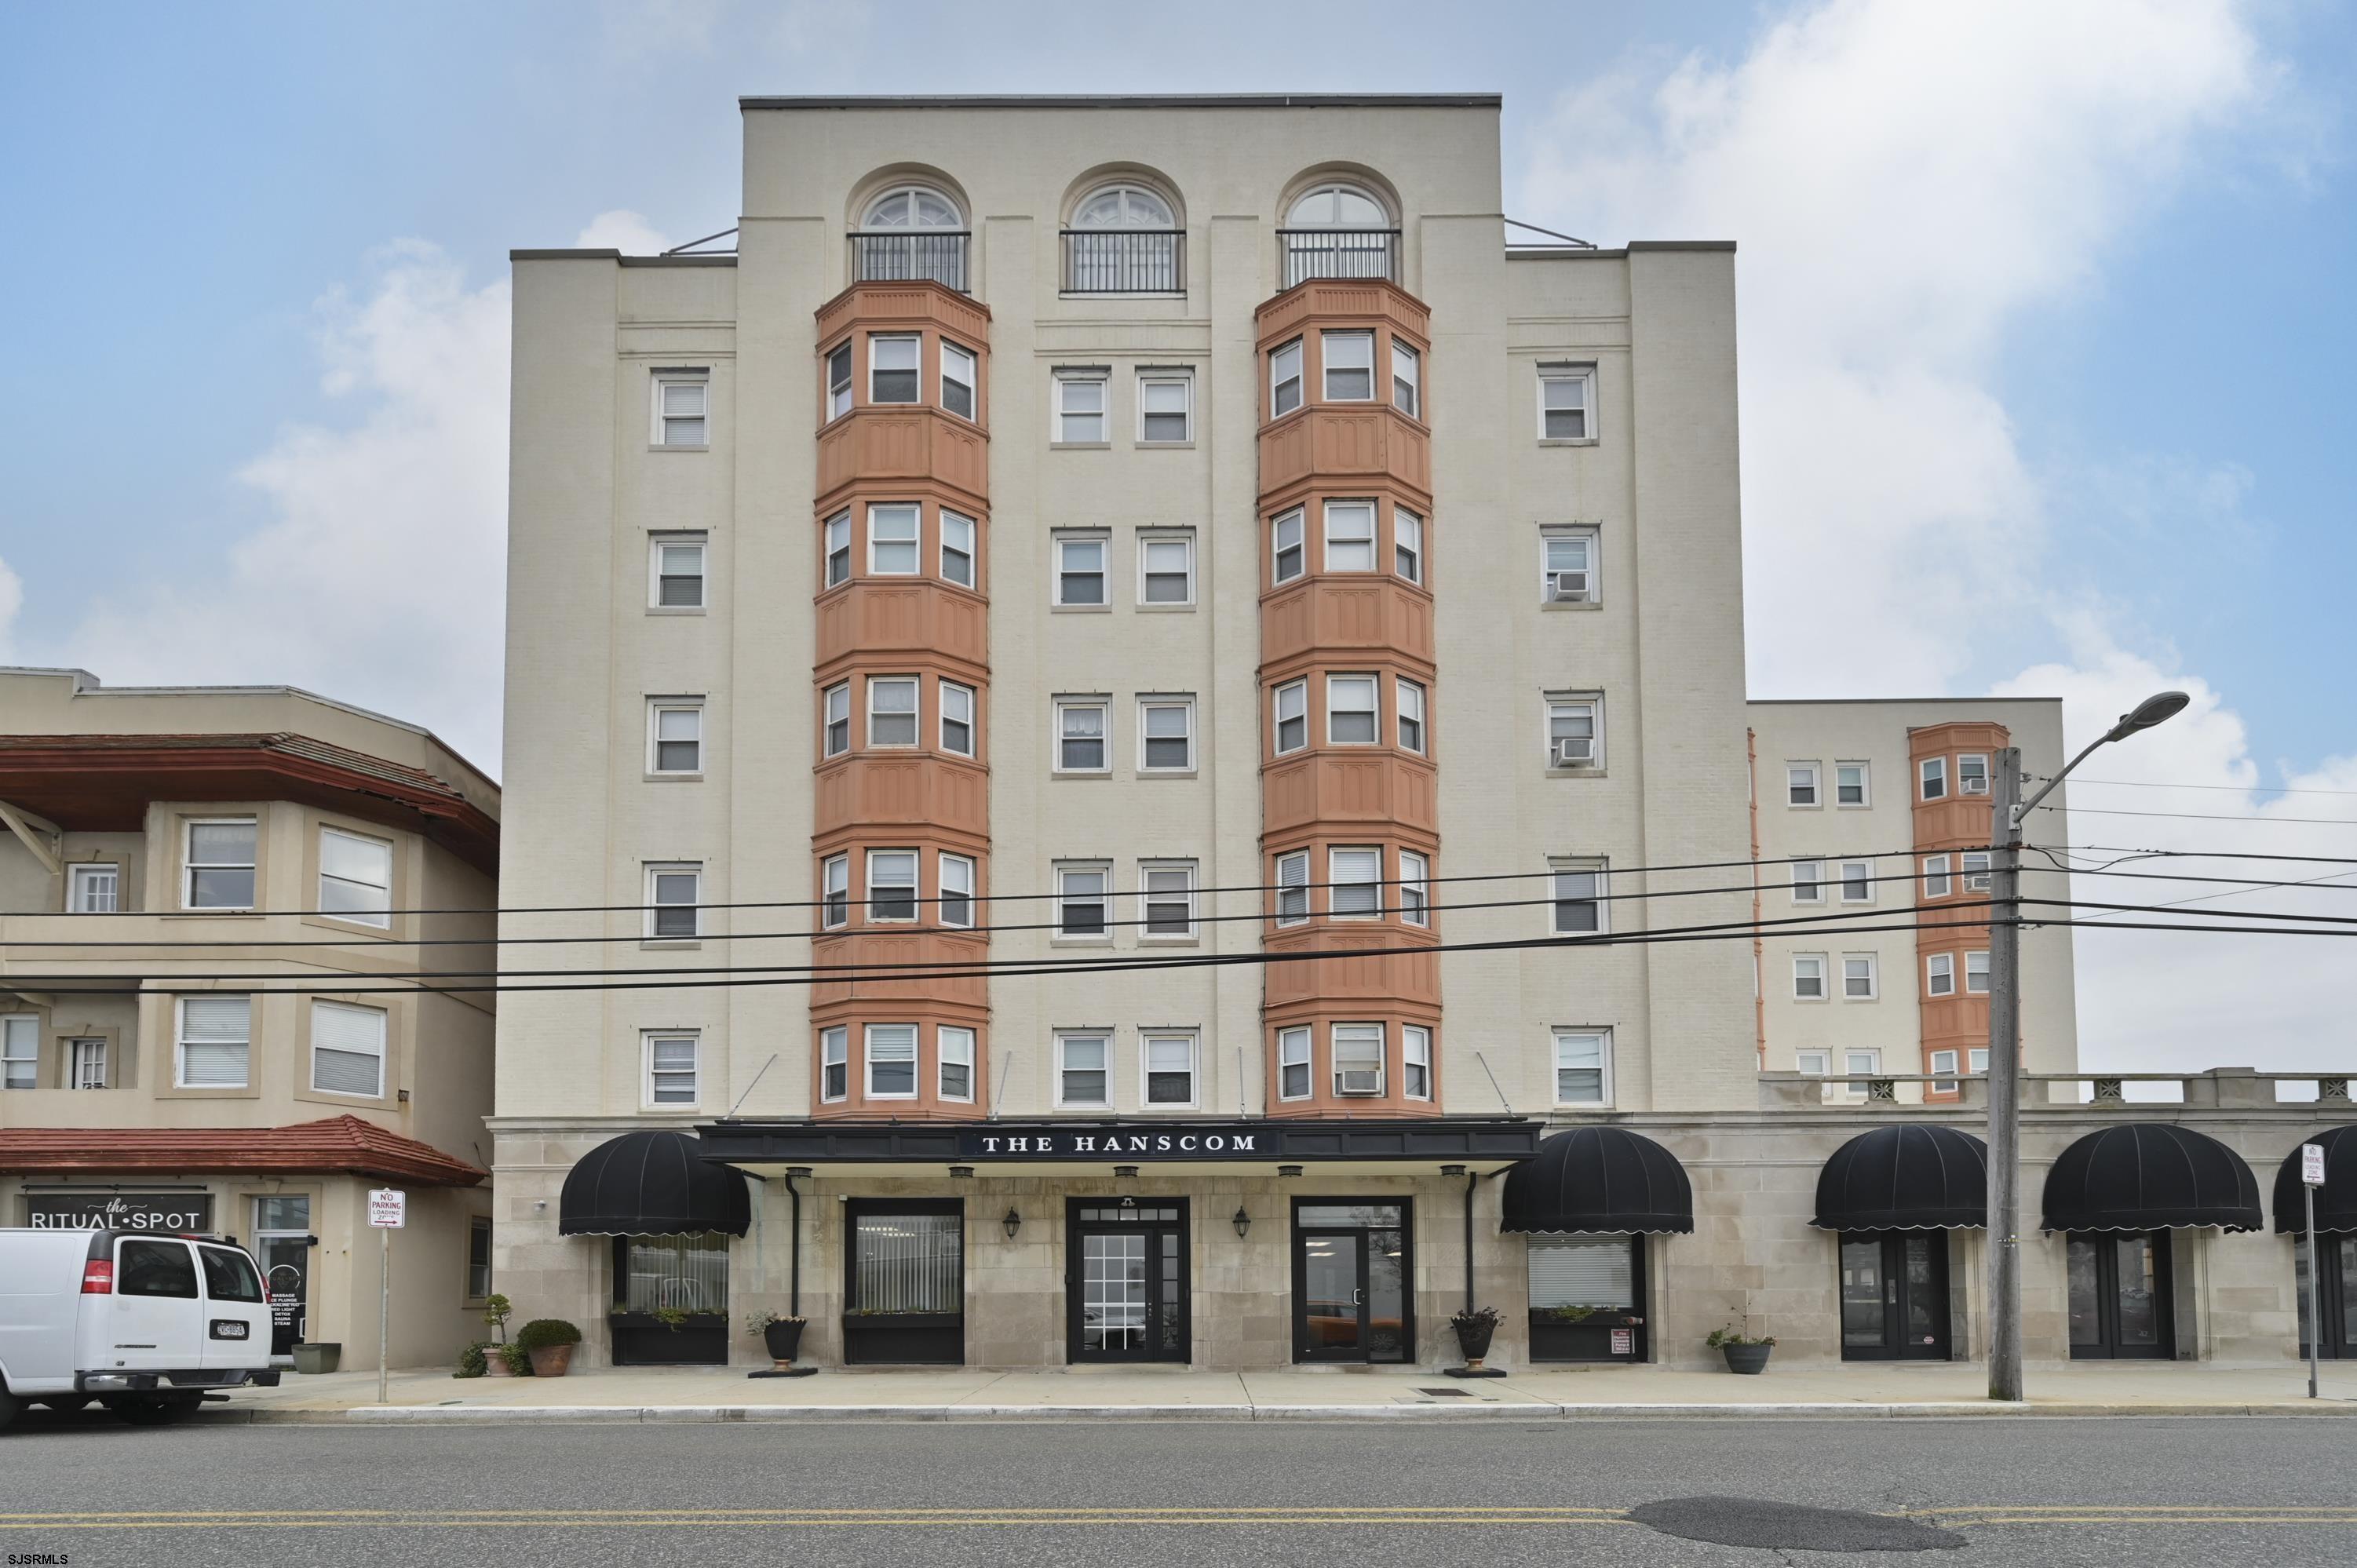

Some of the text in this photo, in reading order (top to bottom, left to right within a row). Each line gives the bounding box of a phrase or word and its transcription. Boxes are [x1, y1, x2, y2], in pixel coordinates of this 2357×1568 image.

[983, 1136, 1255, 1151] THE HANSCOM
[106, 1198, 128, 1213] the
